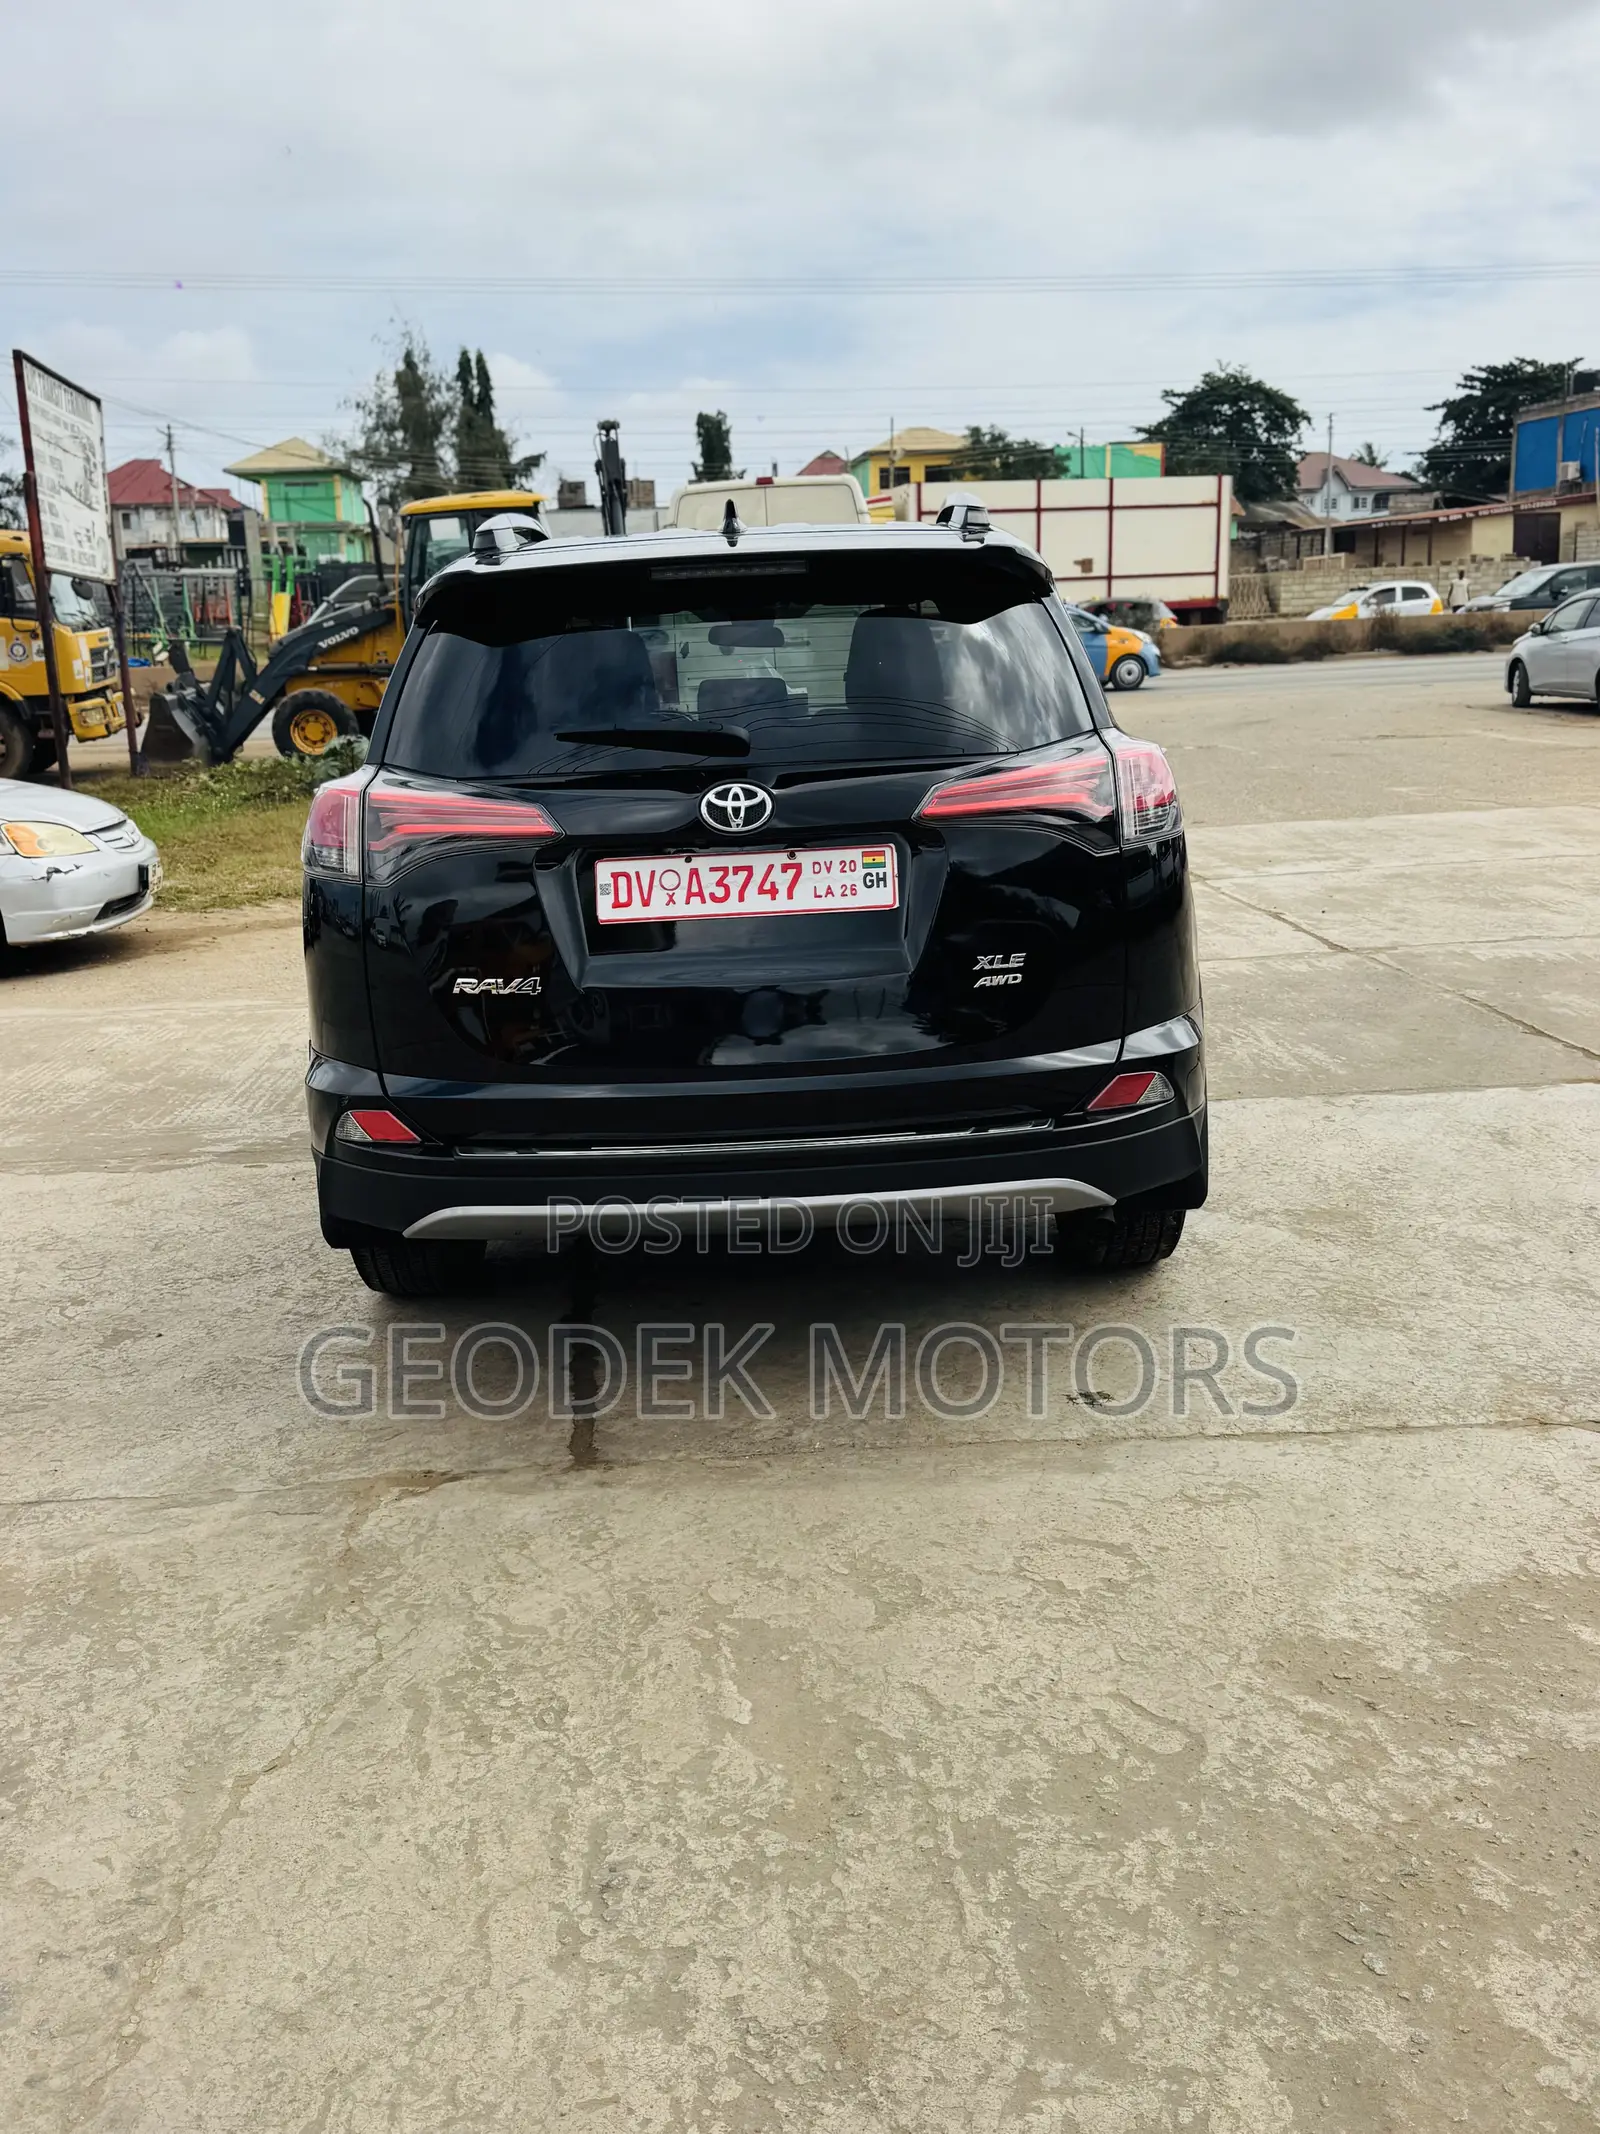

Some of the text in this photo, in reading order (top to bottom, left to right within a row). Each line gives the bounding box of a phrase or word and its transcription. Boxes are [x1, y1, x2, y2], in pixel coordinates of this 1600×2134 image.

[318, 626, 360, 649] VOLVO
[812, 860, 857, 874] DV 20
[610, 869, 656, 909] DV
[685, 862, 802, 905] A3747
[863, 872, 887, 889] GH
[813, 884, 858, 898] LA 26
[972, 953, 1027, 970] XLE
[452, 976, 542, 995] RAV4
[973, 973, 1023, 989] AWD
